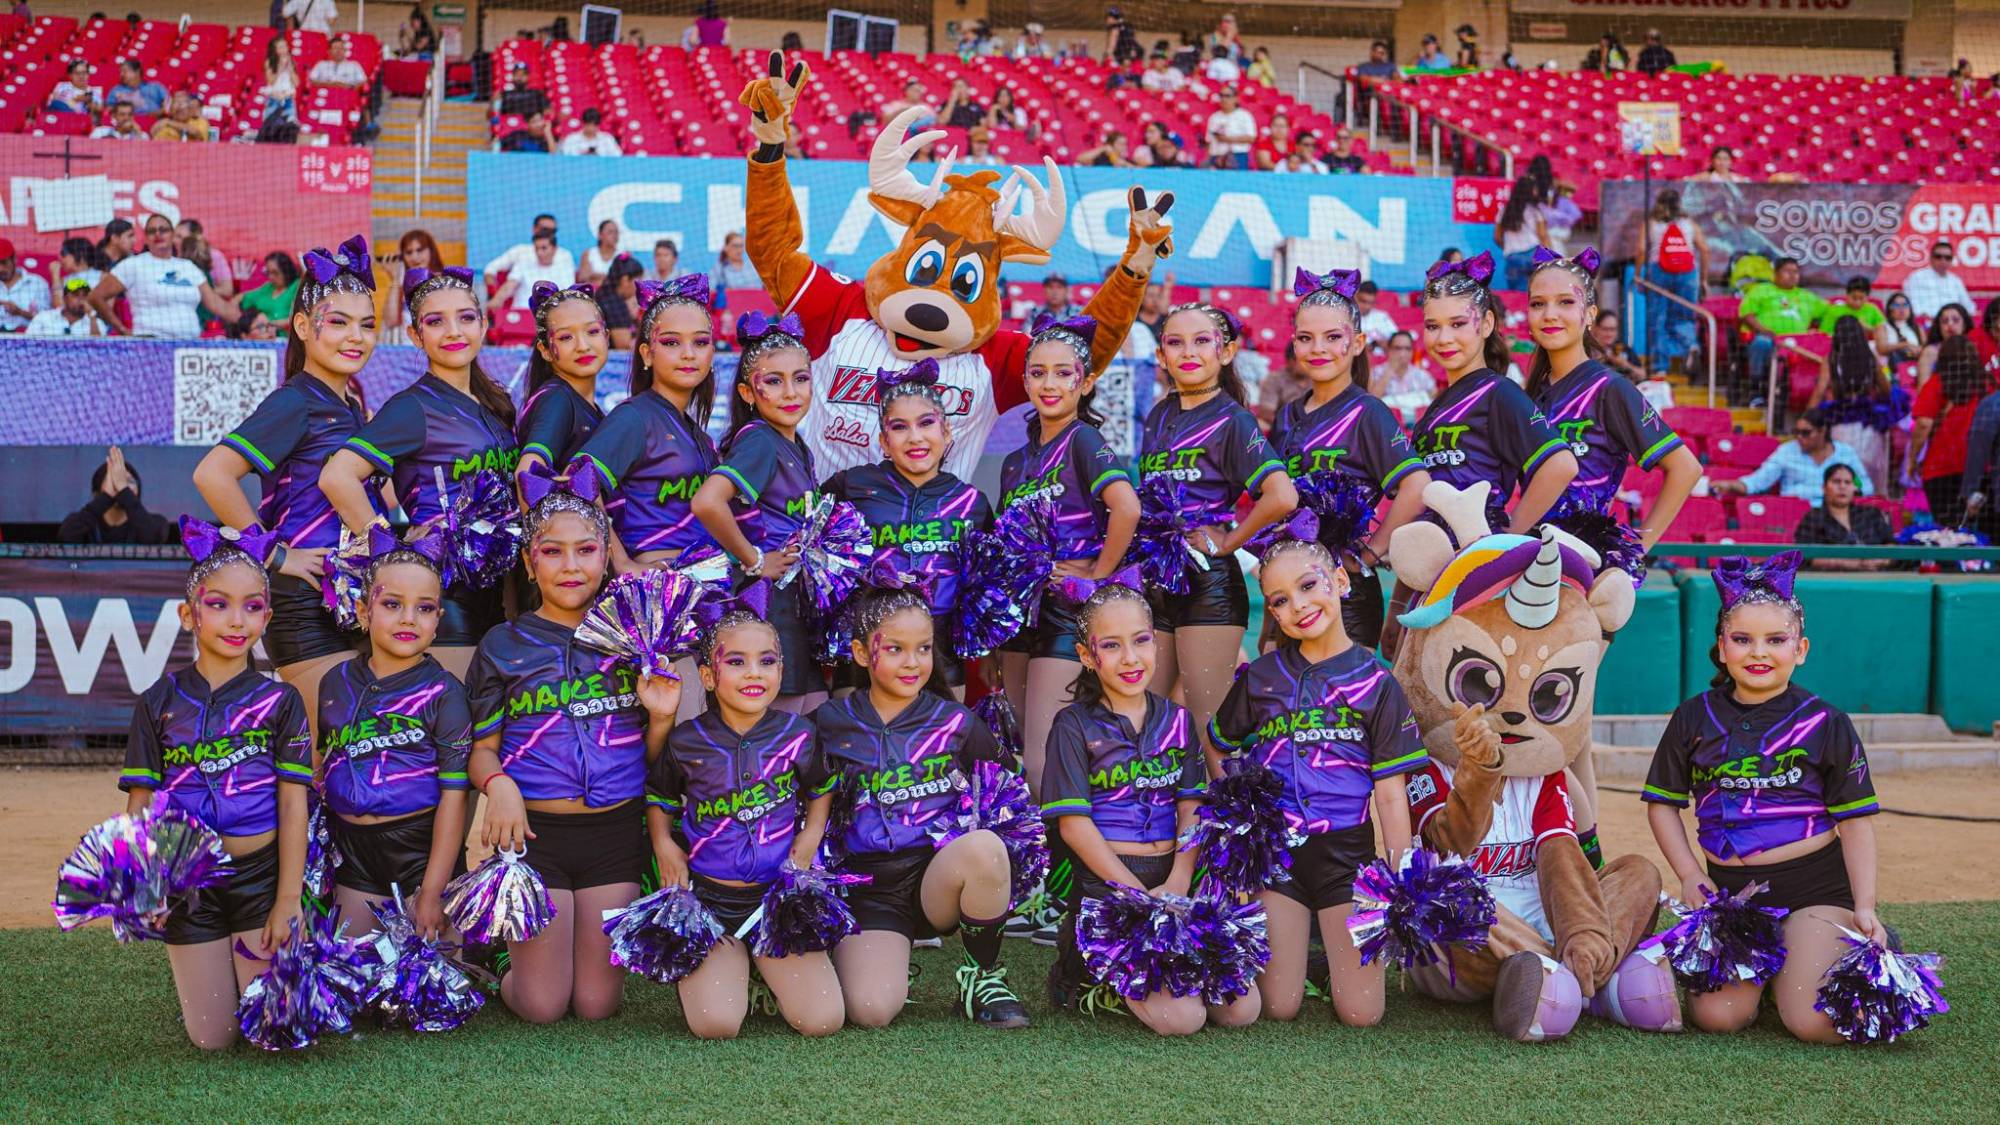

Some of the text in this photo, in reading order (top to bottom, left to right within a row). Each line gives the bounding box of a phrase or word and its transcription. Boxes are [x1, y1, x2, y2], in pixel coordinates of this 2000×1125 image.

[1755, 199, 1901, 234] SOMOS
[1783, 233, 1929, 267] SOMOS
[1433, 425, 1469, 451] IT
[1172, 448, 1205, 468] IT
[1309, 449, 1347, 472] IT
[508, 674, 608, 719] MAKE
[1259, 709, 1325, 743] MAKE
[163, 729, 272, 768] MAKE IT
[1771, 749, 1808, 775] IT
[923, 754, 952, 782] IT
[697, 769, 795, 822] MAKE IT
